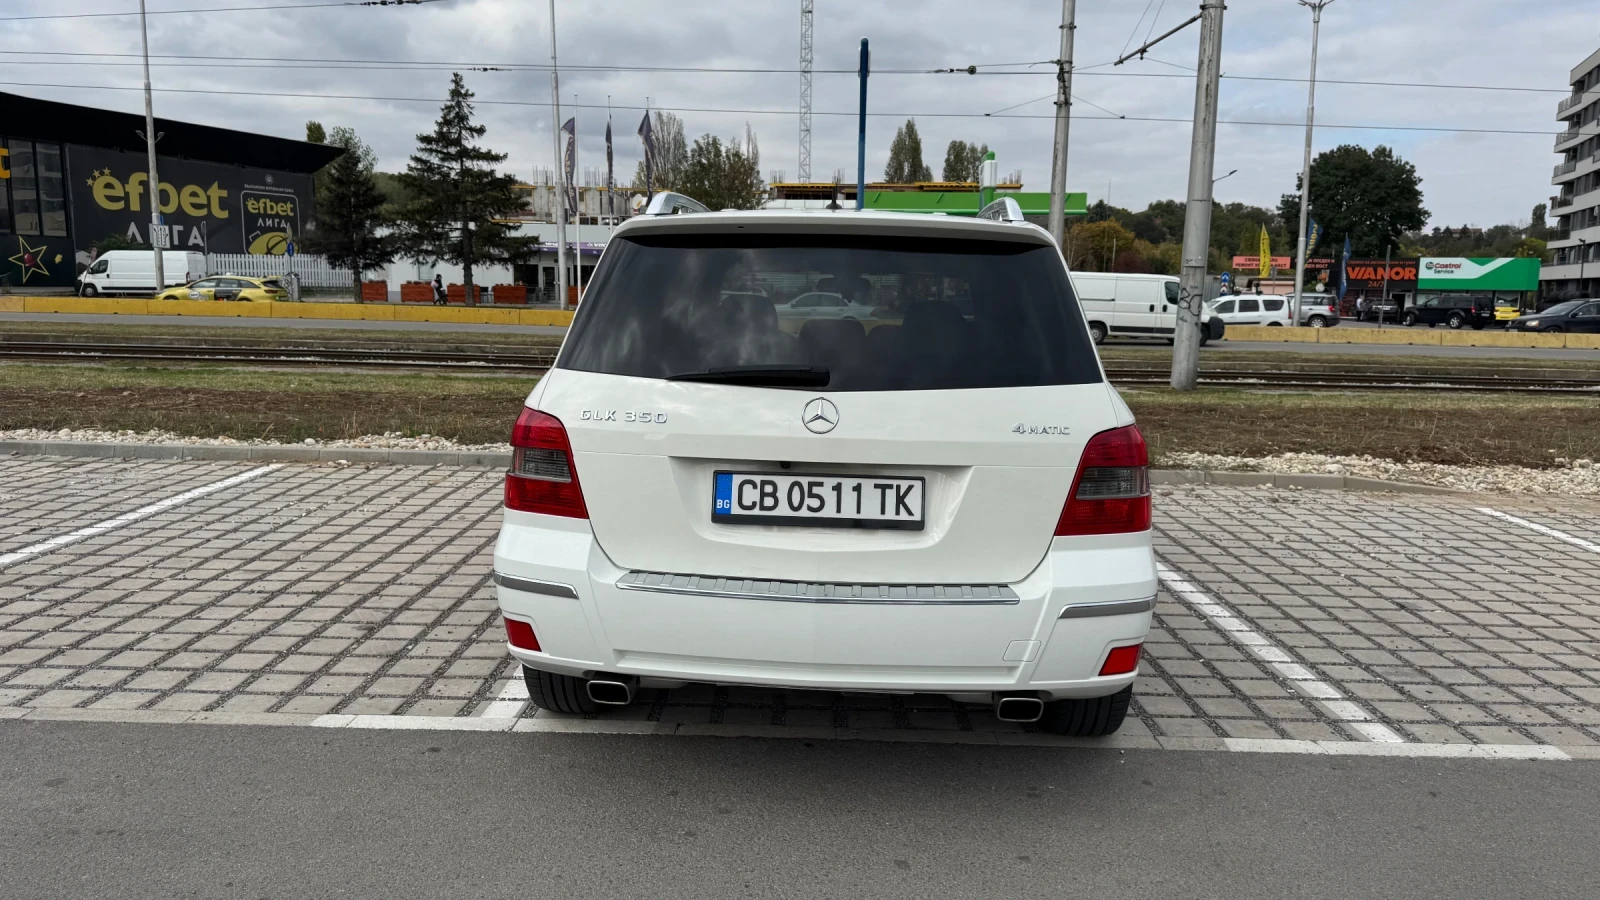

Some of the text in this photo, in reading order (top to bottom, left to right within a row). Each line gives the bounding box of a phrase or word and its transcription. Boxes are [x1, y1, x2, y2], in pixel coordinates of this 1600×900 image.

[93, 172, 229, 219] efbet
[247, 198, 294, 216] efbet
[257, 218, 287, 228] ЛИГА
[1347, 266, 1417, 280] VIANOR
[579, 408, 668, 424] GLK 350
[1012, 422, 1071, 436] 4MATIC
[716, 499, 730, 509] BG
[737, 479, 915, 516] CB 0511 TK
